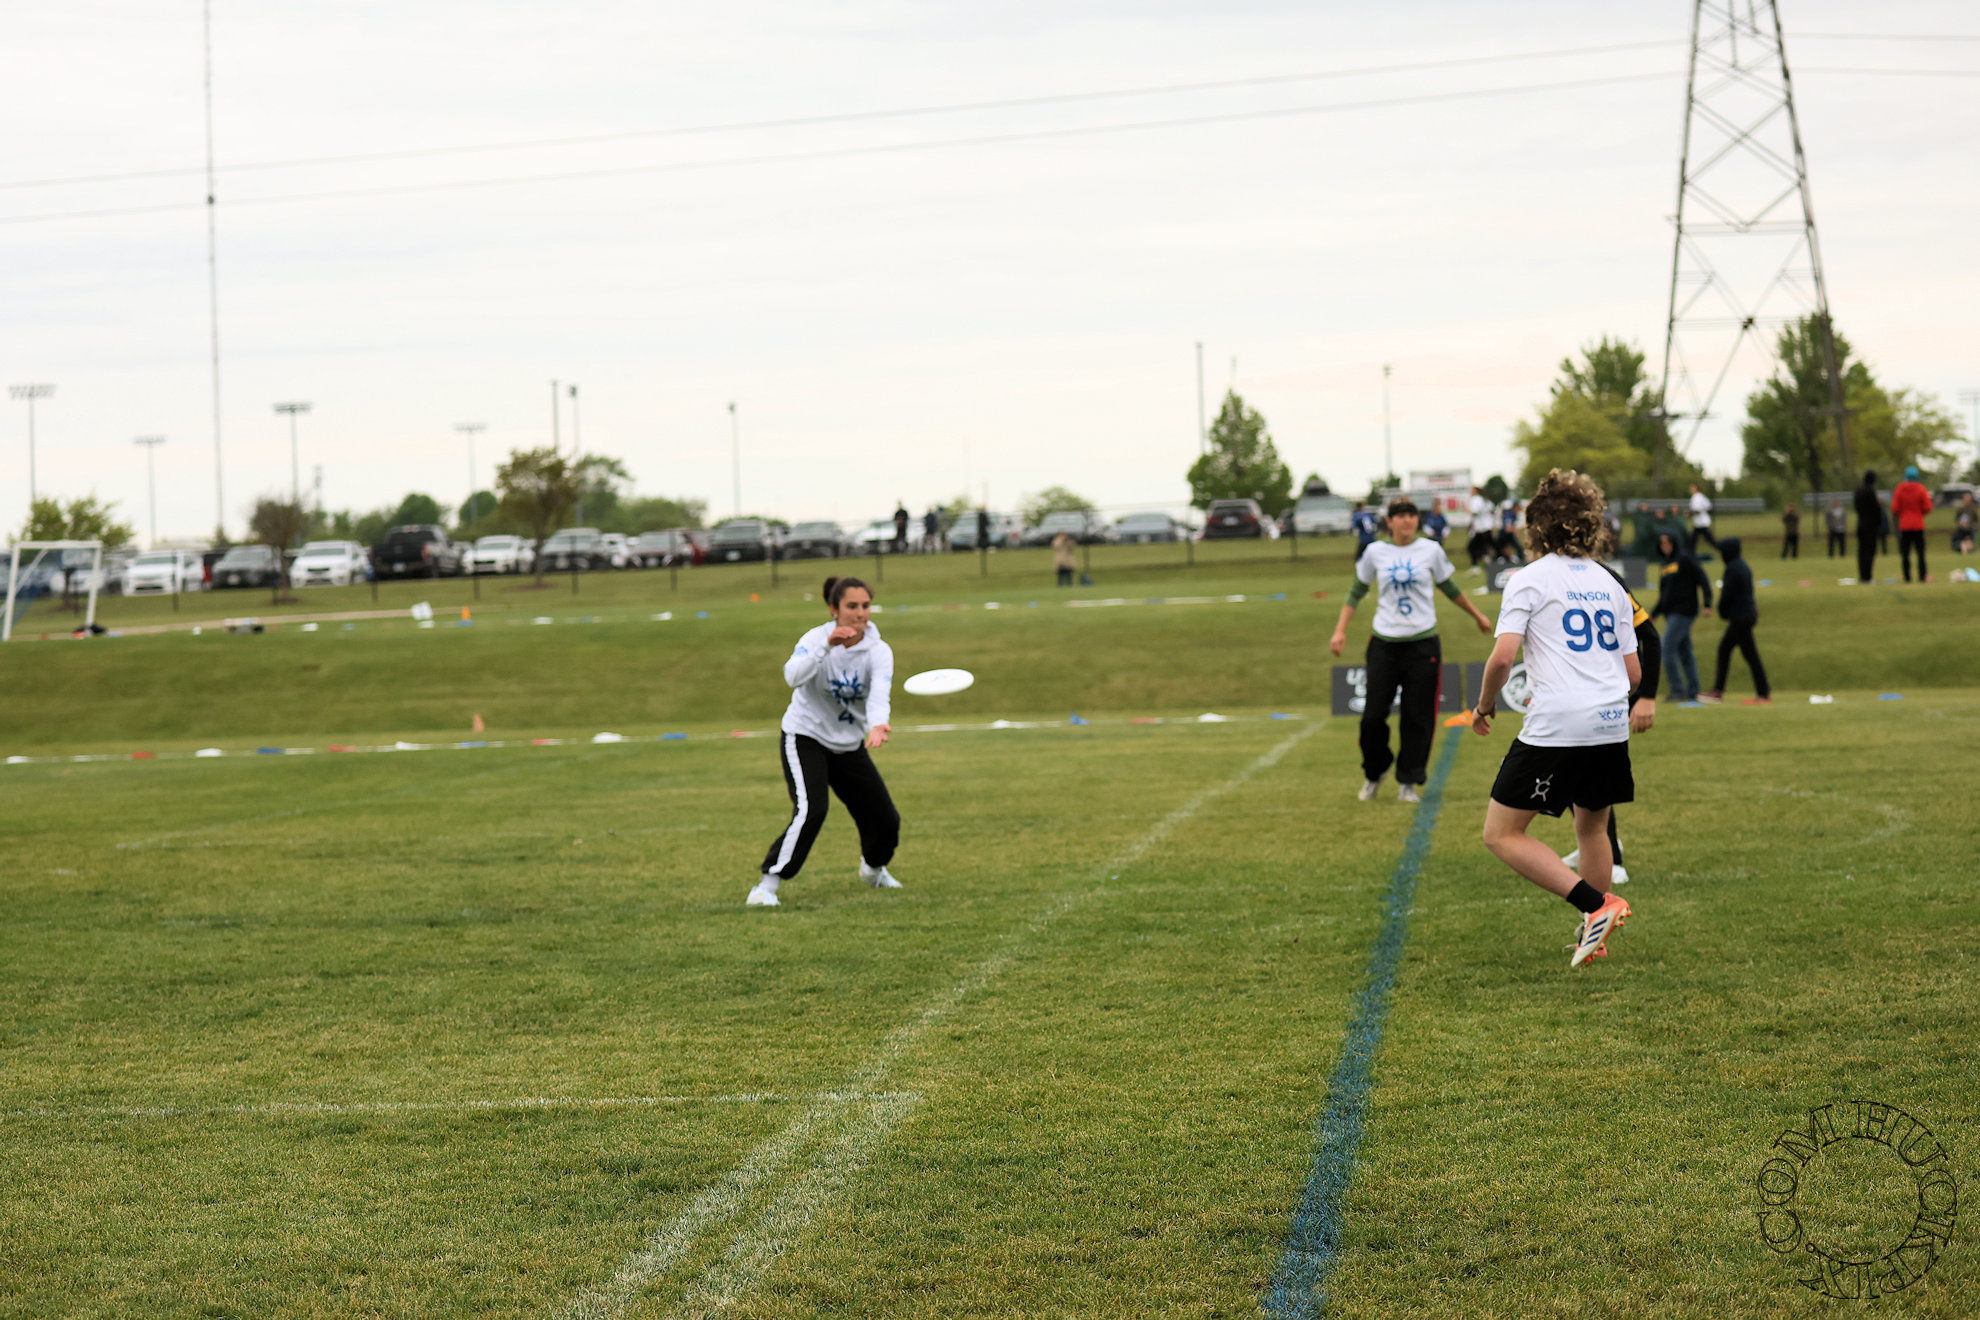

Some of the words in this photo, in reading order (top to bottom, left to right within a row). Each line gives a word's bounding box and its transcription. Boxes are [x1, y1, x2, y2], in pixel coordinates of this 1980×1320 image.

[1398, 596, 1413, 616] 5
[1562, 609, 1619, 652] 98
[838, 709, 855, 725] 4
